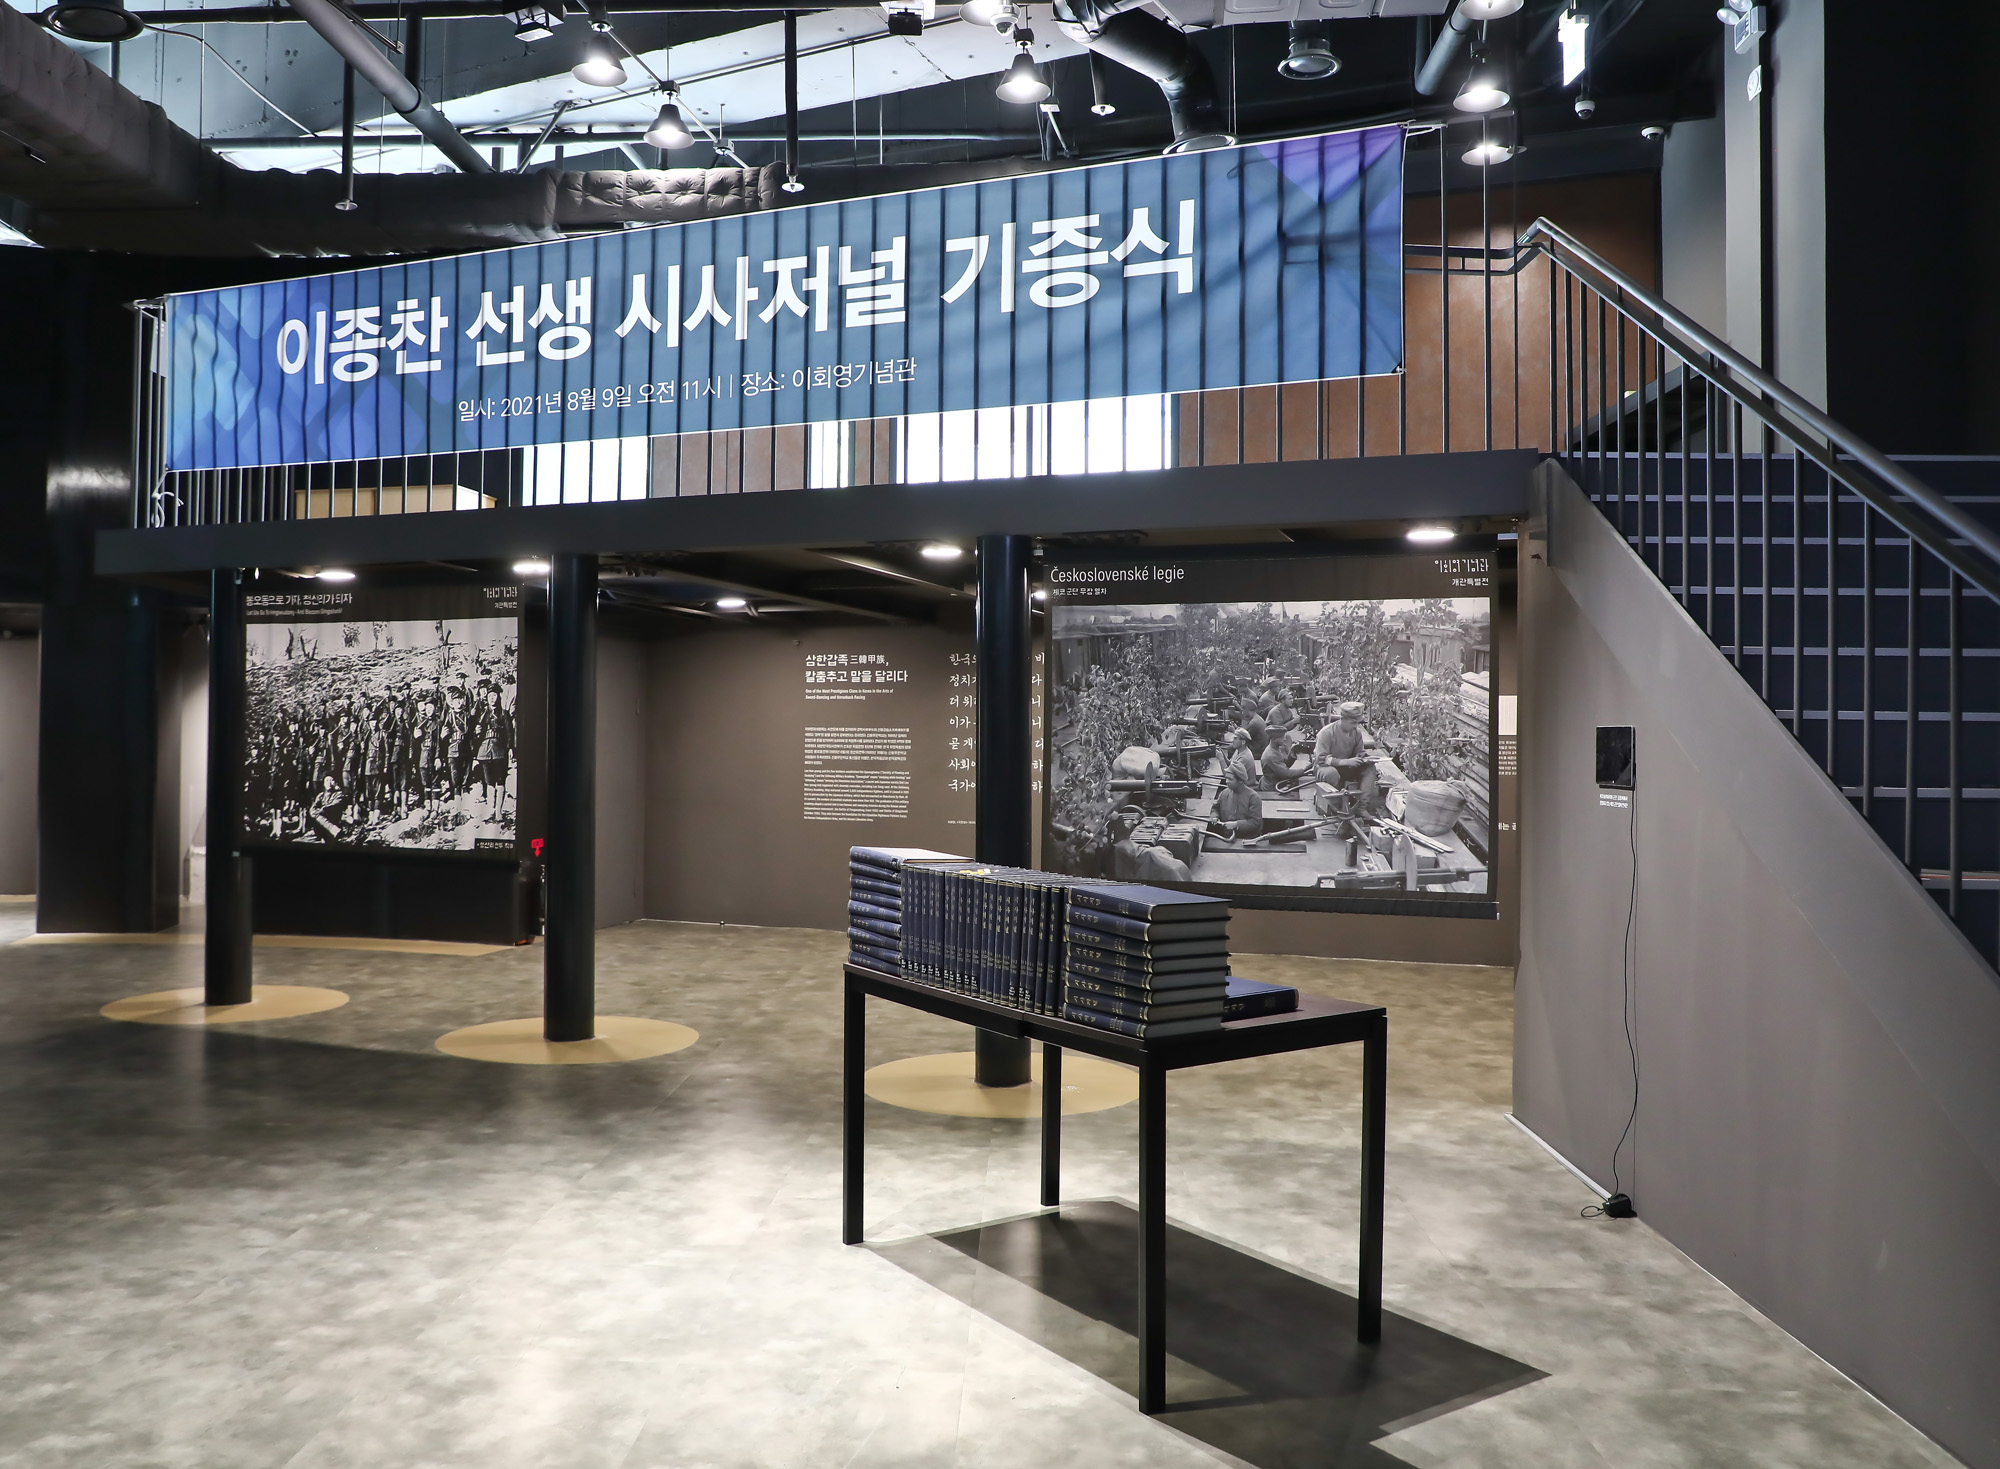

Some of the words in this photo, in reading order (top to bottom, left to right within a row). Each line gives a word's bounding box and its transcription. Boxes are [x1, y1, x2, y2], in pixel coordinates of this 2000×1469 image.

[276, 296, 449, 385] 이종찬
[465, 276, 592, 367] 선생
[614, 235, 907, 348] 시사저널
[940, 198, 1195, 313] 기증식
[458, 397, 496, 422] 일시:
[500, 390, 562, 418] 2021년
[567, 387, 597, 412] 8월
[602, 384, 632, 408] 9일
[636, 380, 675, 405] 오전
[682, 375, 721, 401] 11시
[741, 371, 786, 397] 장소:
[792, 356, 918, 391] 이회영기념관
[1050, 565, 1149, 583] Československé
[1153, 564, 1185, 583] legie
[1079, 587, 1093, 596] 무장
[805, 653, 849, 667] 삼한갑족
[805, 670, 849, 683] 칼춤추고
[850, 670, 873, 683] 말을
[875, 670, 909, 683] 달리다
[962, 694, 976, 708] 위
